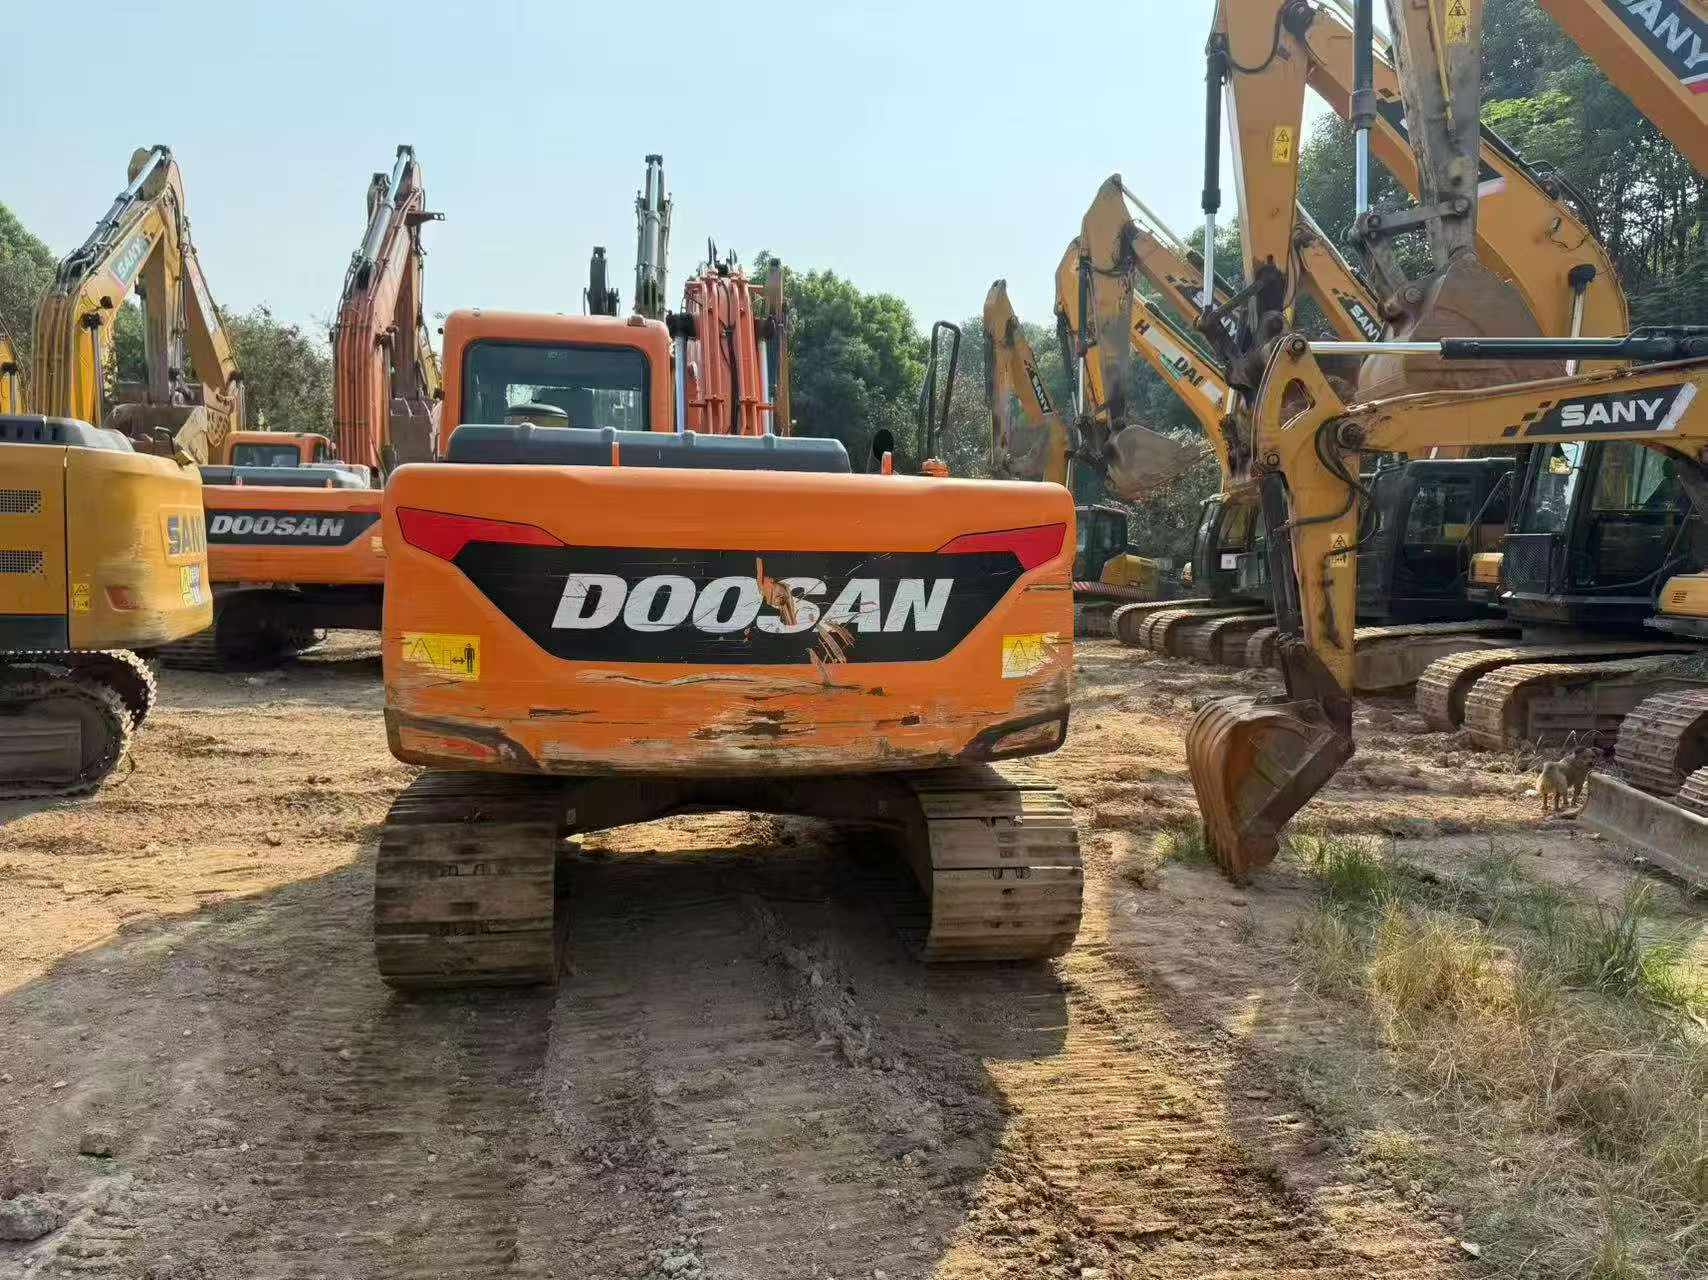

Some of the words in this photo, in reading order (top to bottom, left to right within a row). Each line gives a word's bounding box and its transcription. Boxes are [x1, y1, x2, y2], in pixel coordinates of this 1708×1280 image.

[1619, 0, 1708, 69] ANY
[1561, 397, 1664, 427] SANY
[210, 515, 345, 536] DOOSAN
[551, 573, 955, 634] DOOSAN
